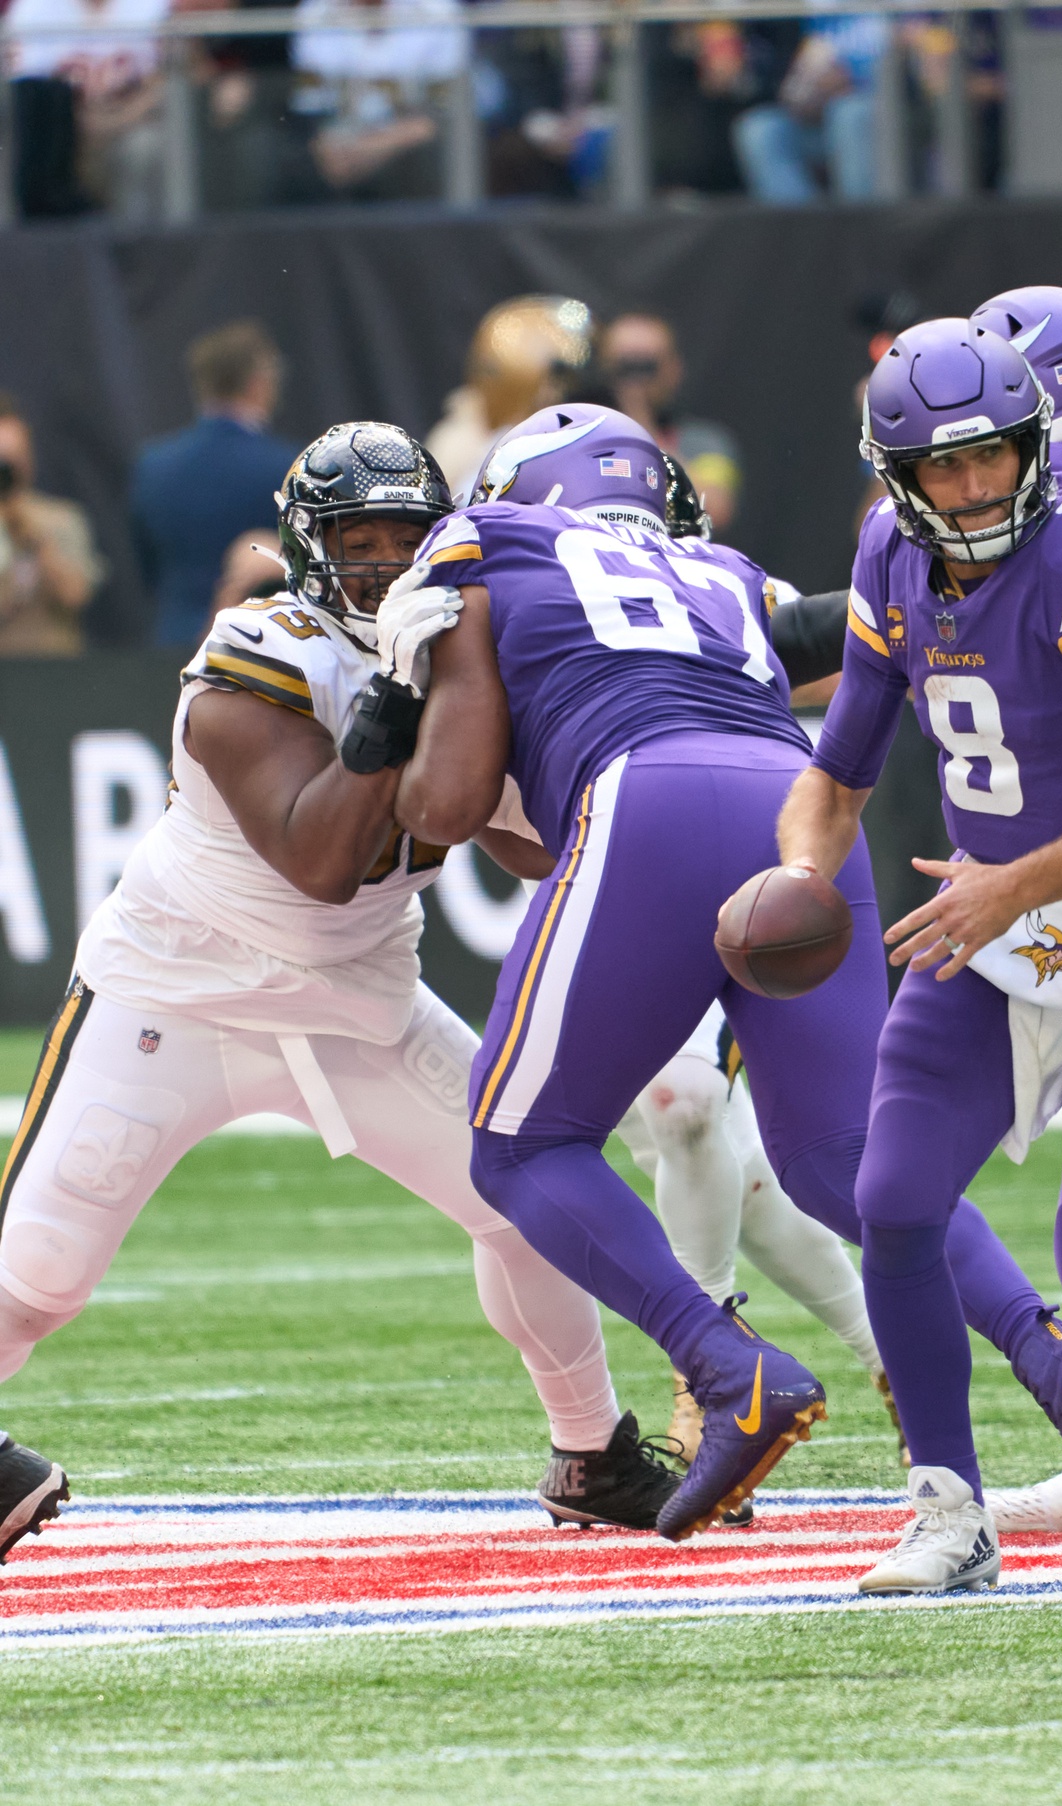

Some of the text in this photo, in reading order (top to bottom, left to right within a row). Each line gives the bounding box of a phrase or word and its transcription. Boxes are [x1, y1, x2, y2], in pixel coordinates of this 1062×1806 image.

[384, 491, 414, 499] SAINTS
[597, 512, 666, 535] INSPIRE CHAN
[555, 529, 776, 687] 67
[924, 675, 1024, 817] 8
[957, 1543, 996, 1573] adidas
